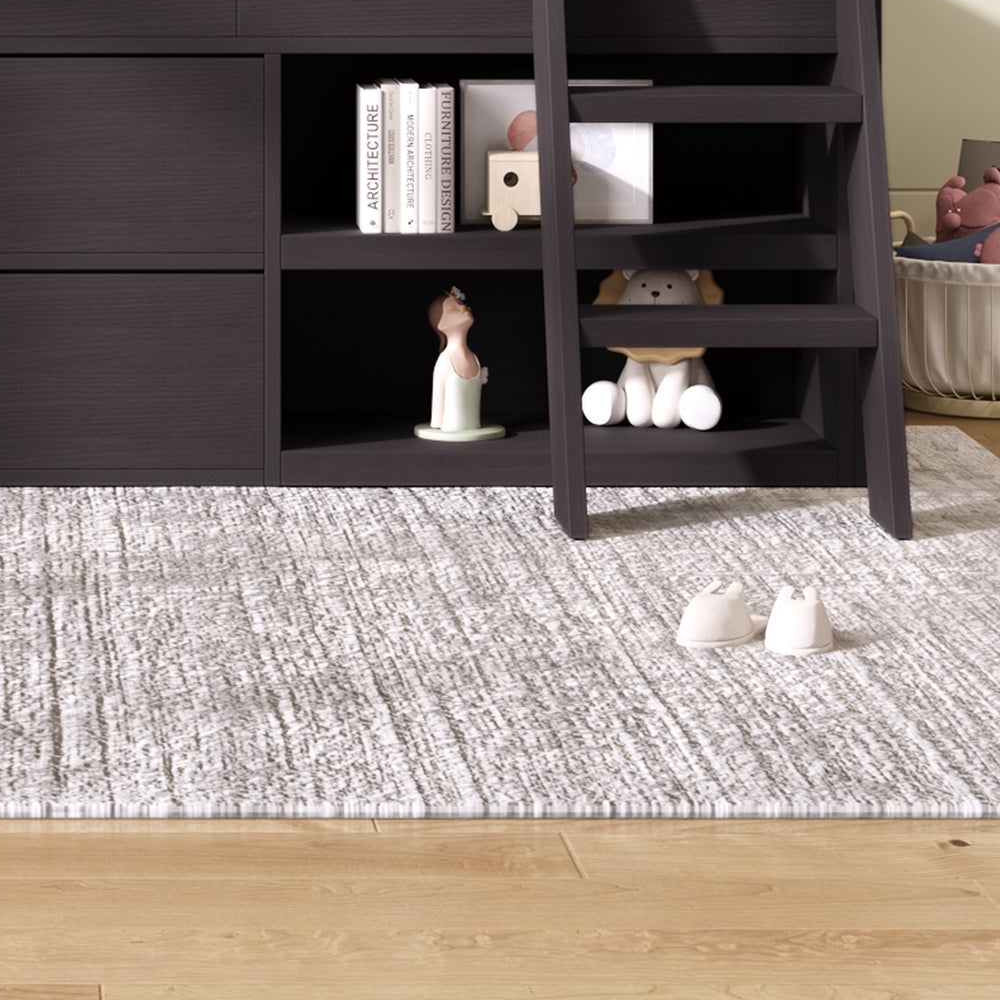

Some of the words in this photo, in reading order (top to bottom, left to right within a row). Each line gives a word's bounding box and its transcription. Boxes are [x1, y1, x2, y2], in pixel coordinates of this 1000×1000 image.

[366, 104, 379, 210] ARCHITECTURE
[406, 114, 414, 148] MODERN
[424, 132, 432, 180] CLOTHING
[440, 91, 451, 175] FURNITURE
[406, 150, 414, 209] ARCHITECTURE
[440, 179, 451, 232] DESIGN
